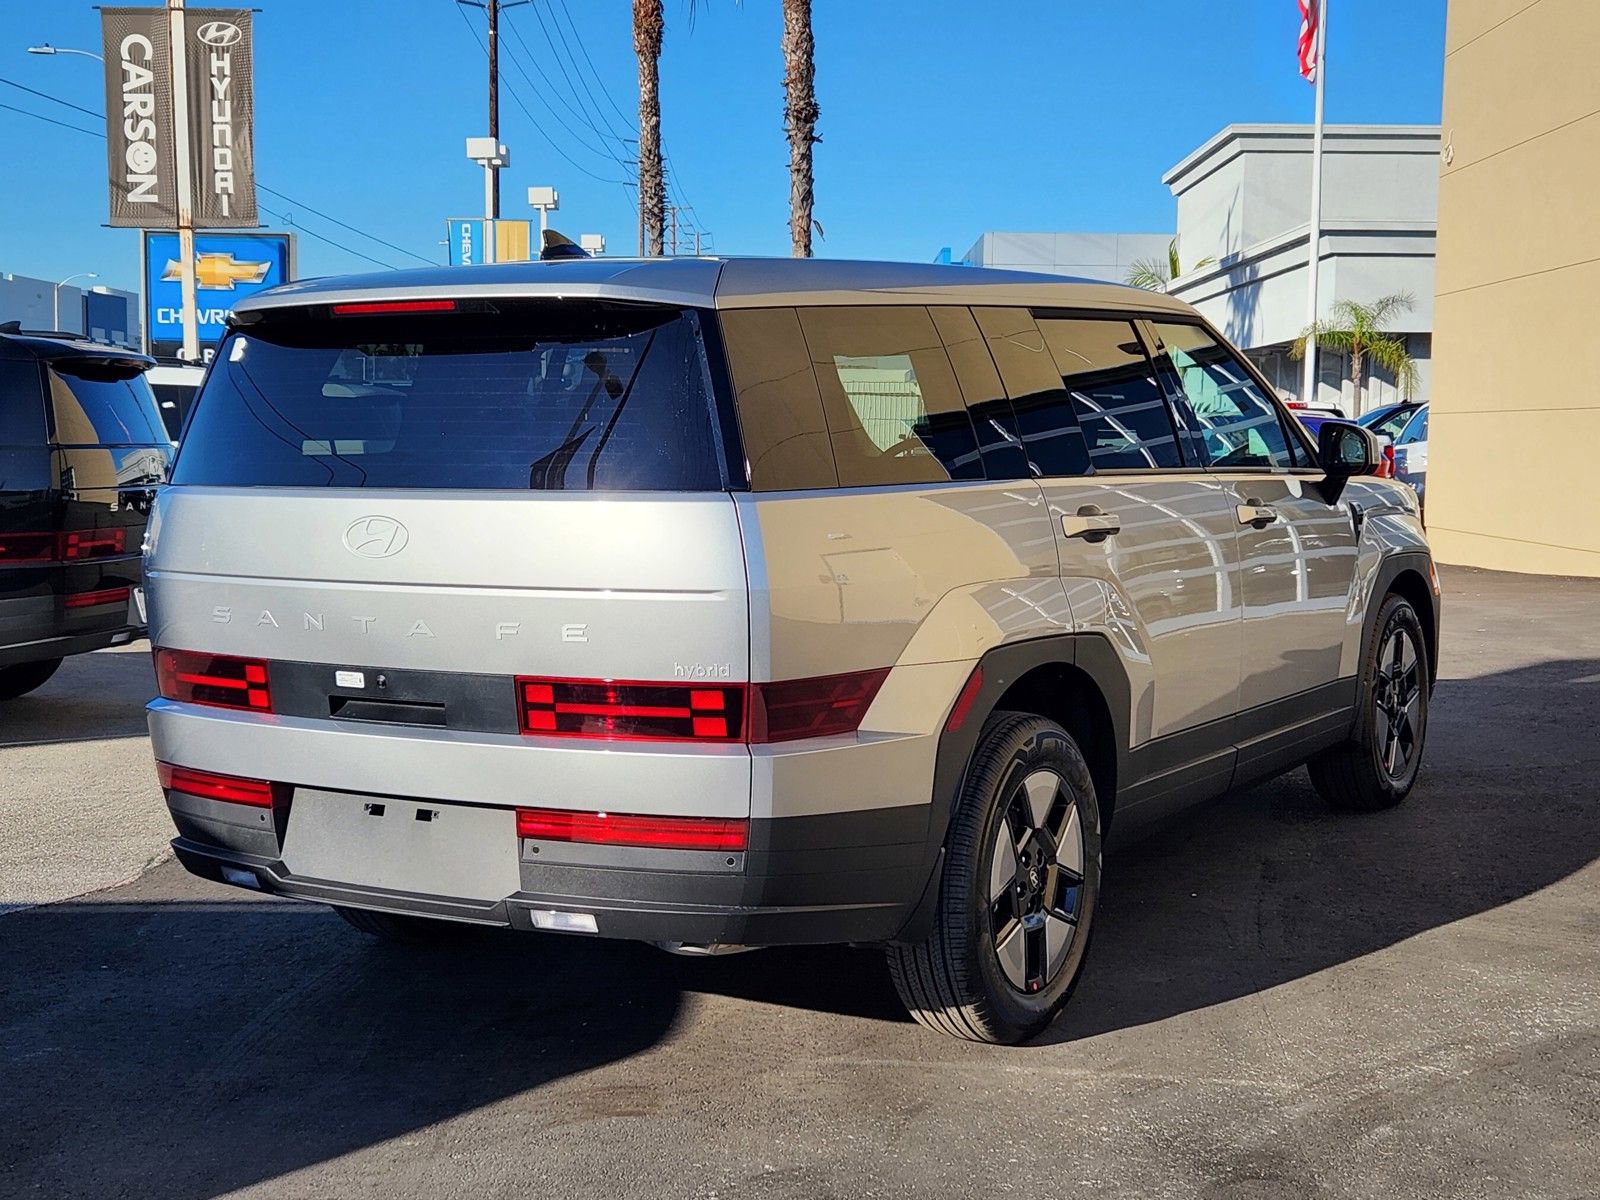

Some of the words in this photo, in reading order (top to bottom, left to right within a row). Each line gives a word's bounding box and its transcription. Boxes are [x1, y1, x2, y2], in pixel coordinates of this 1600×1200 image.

[120, 33, 159, 203] CARSON
[210, 53, 234, 217] HYUNDAI
[462, 223, 472, 265] CHEV
[157, 308, 231, 325] CHVR
[211, 605, 436, 640] SANTA
[496, 621, 590, 643] FE
[674, 662, 731, 680] hybrid
